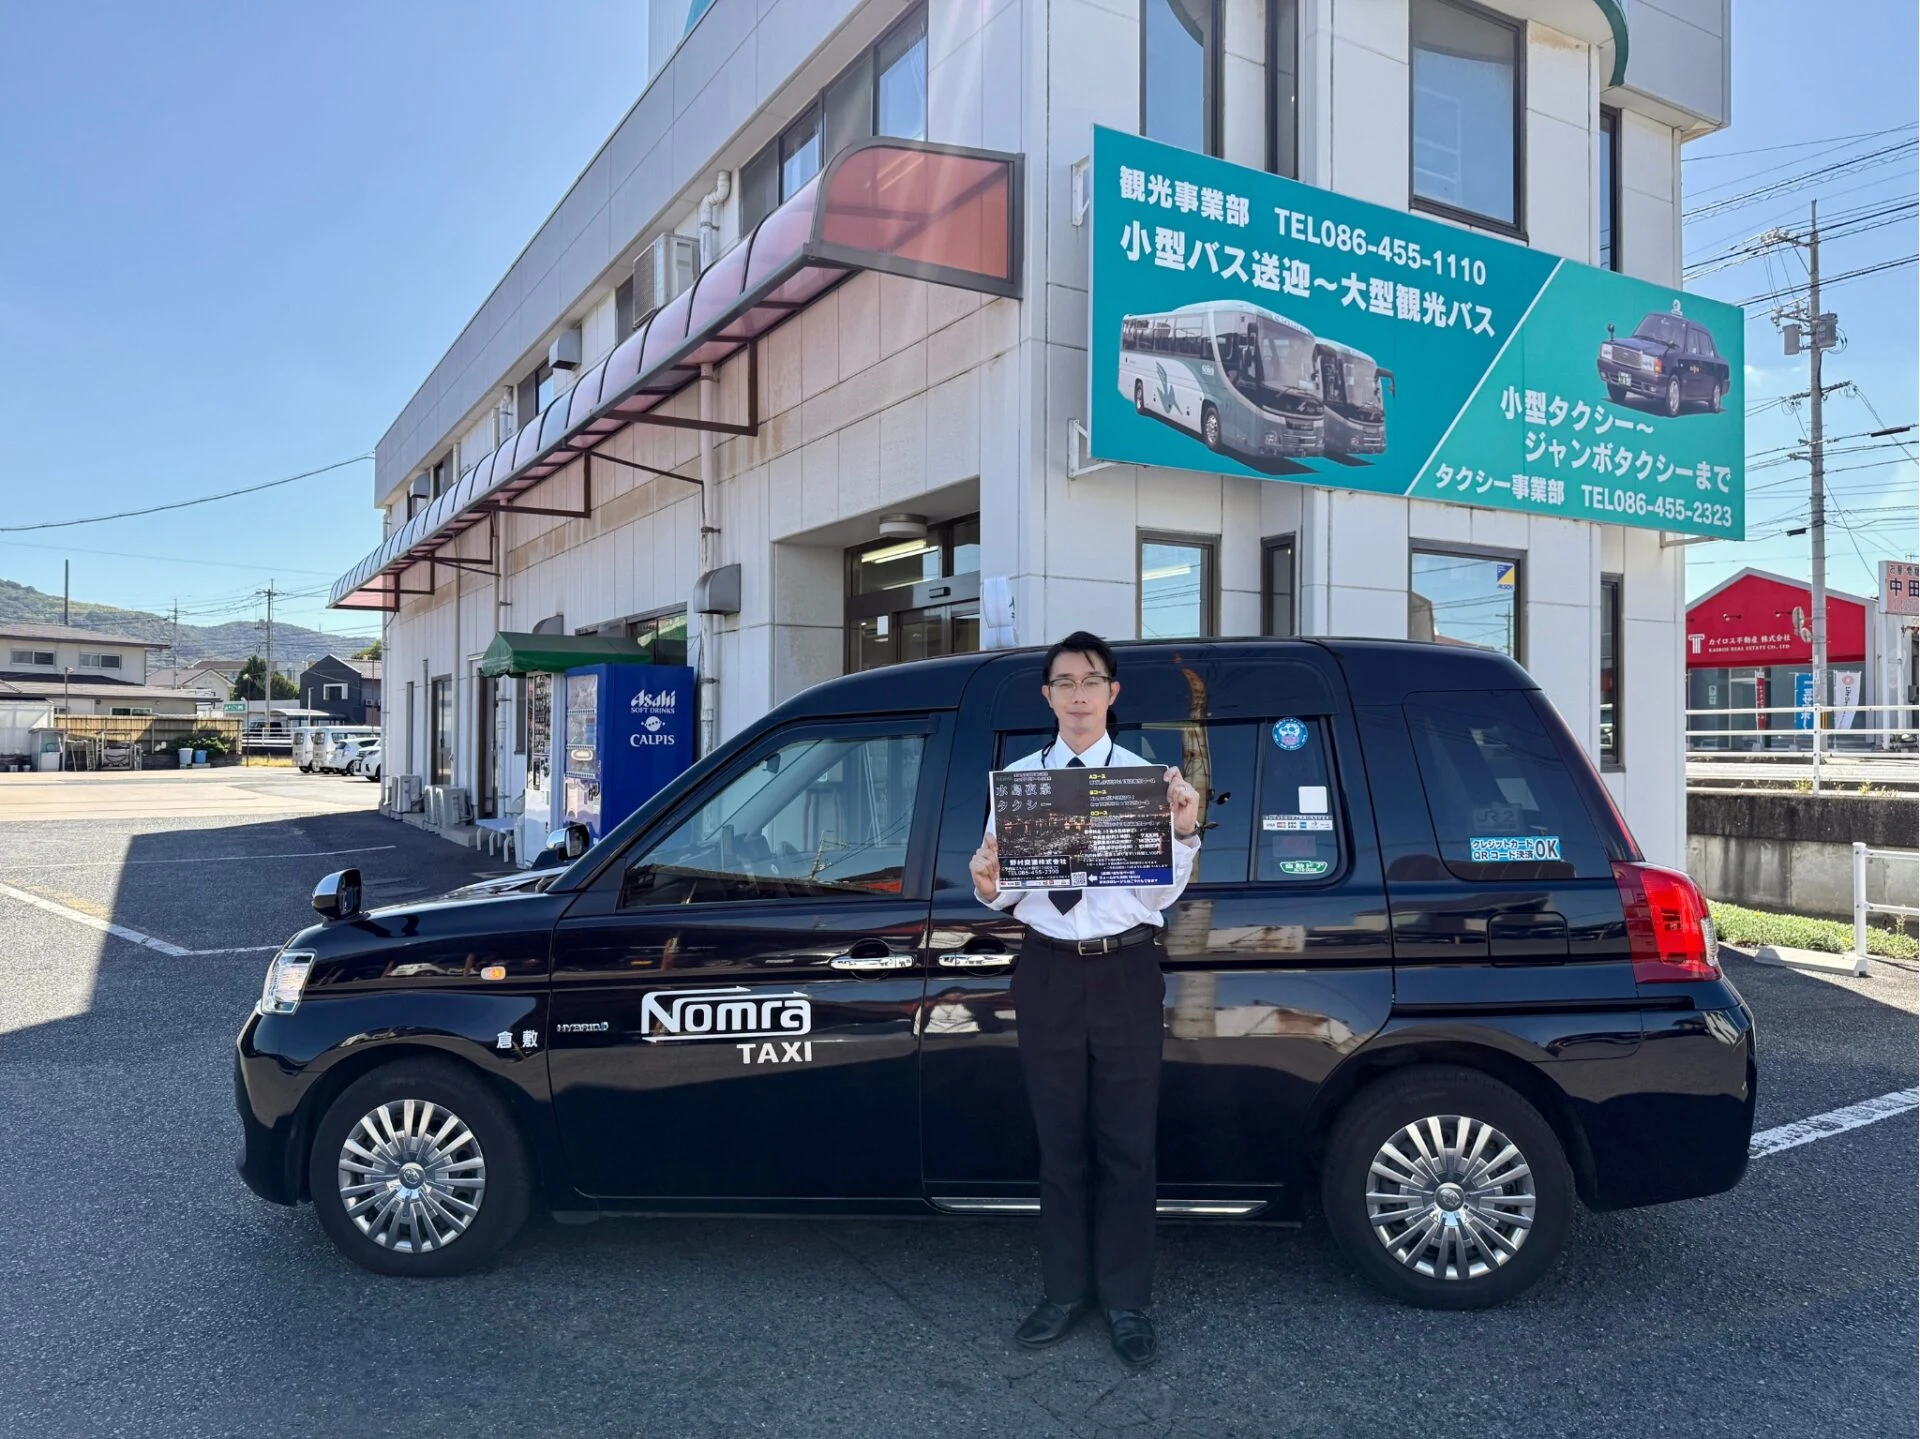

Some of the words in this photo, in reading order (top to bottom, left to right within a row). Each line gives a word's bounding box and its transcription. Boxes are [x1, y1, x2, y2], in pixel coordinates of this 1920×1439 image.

[1119, 165, 1250, 228] 観光事業部
[1274, 207, 1487, 286] TEL086-455-1110
[1524, 430, 1732, 493] ジャンボタクシーまで
[1435, 463, 1565, 506] タクシー事業部
[1581, 485, 1733, 528] TEL086-455-2323
[1709, 635, 1758, 645] カイロス不動産
[1761, 634, 1791, 643] 株式会社
[630, 689, 676, 708] Asahi
[630, 734, 675, 747] CALPIS
[1472, 840, 1533, 849] クレジットカード
[1535, 839, 1559, 860] OK
[641, 985, 812, 1043] Nomra
[557, 1023, 603, 1032] HYBRID
[737, 1042, 813, 1065] TAXI
